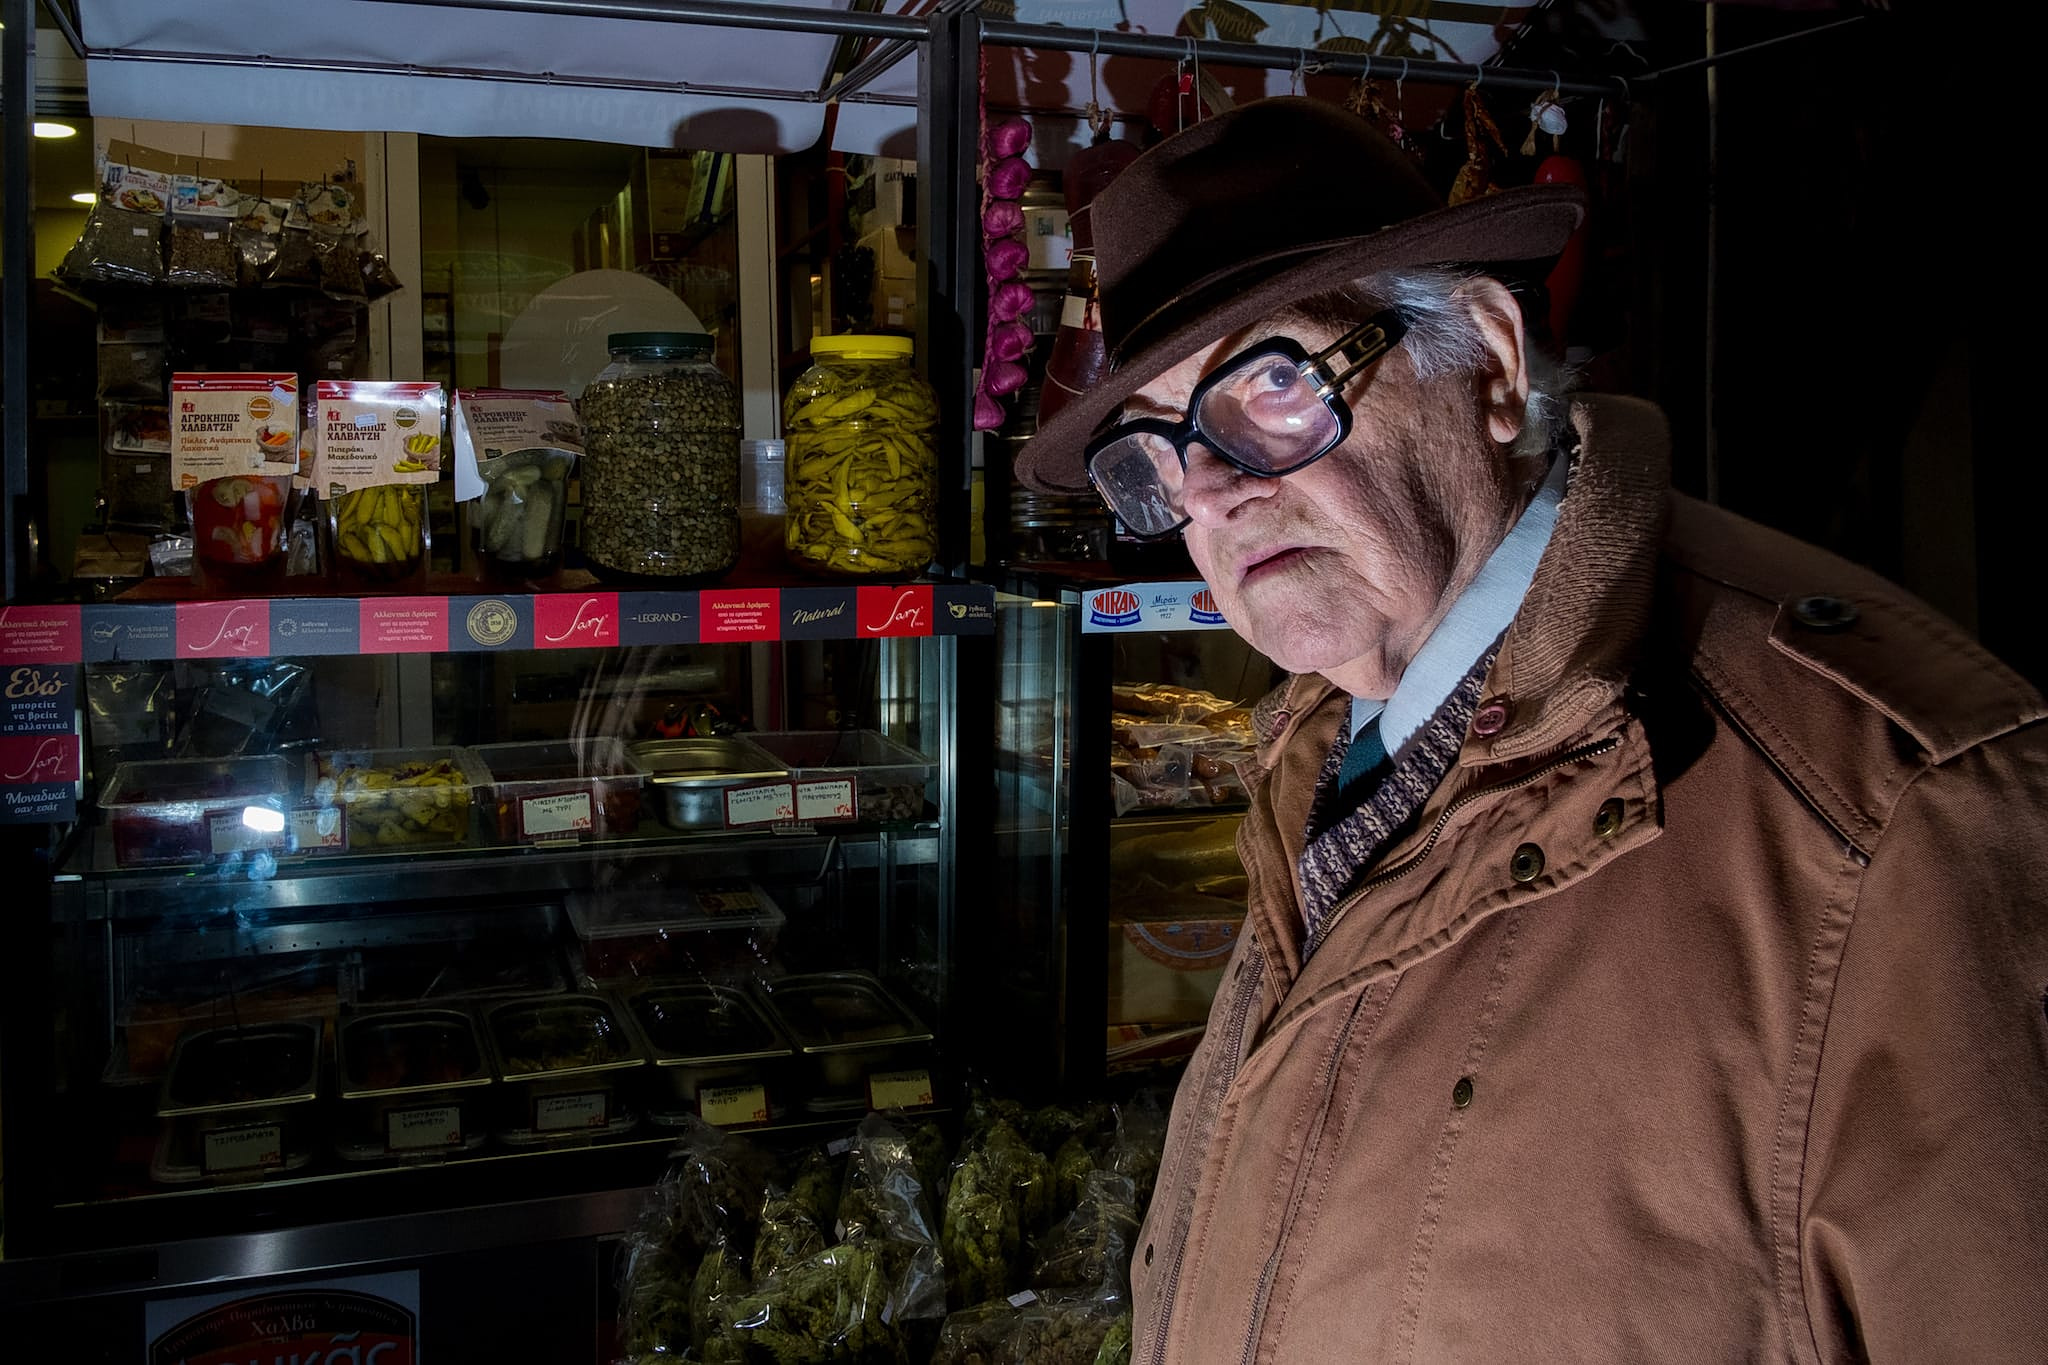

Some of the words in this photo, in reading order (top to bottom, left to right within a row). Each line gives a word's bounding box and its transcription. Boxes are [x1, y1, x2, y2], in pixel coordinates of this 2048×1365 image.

[181, 414, 240, 423] ΑΓΡΟΚΗΠΟΣ
[181, 423, 233, 432] ΧΑΛΒΑΤΖΗ
[327, 432, 380, 441] ΧΑΛΒΑΤΖΗ
[1093, 591, 1139, 615] MIRAN
[792, 601, 846, 625] Natural
[866, 590, 922, 632] Sary
[545, 598, 606, 641] Sary
[638, 614, 682, 623] LEGRAND
[188, 606, 255, 650] Sary
[5, 667, 70, 698] Εδώ
[11, 700, 57, 711] μπορείτε
[13, 712, 25, 720] να
[28, 711, 59, 721] βρείτε
[18, 721, 69, 731] αλλαντικά
[4, 737, 64, 779] Sary
[5, 787, 68, 805] Μοναδικά
[14, 805, 33, 814] σαν
